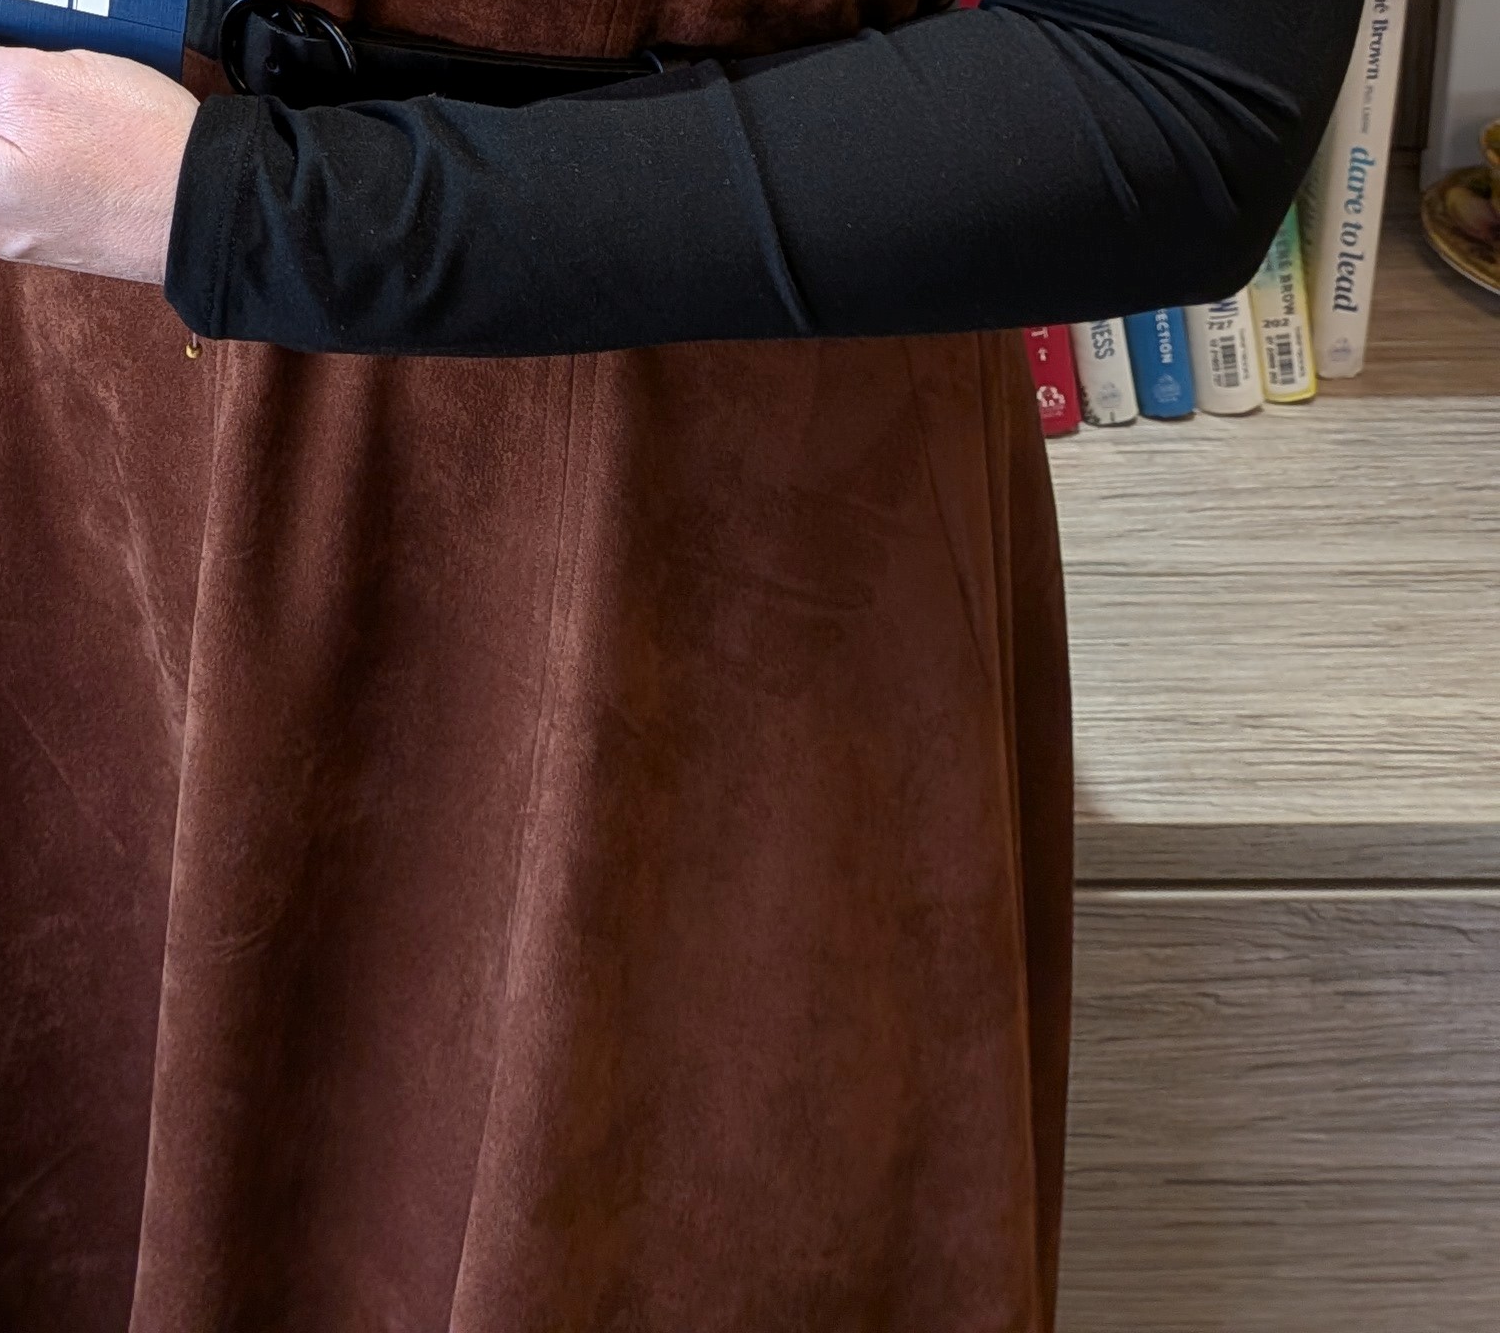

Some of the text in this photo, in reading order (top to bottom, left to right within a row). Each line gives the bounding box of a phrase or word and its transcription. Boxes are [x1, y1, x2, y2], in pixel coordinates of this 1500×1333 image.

[1365, 17, 1389, 81] Brown
[1343, 145, 1376, 215] dare
[1340, 217, 1365, 249] to
[1332, 249, 1365, 314] lead
